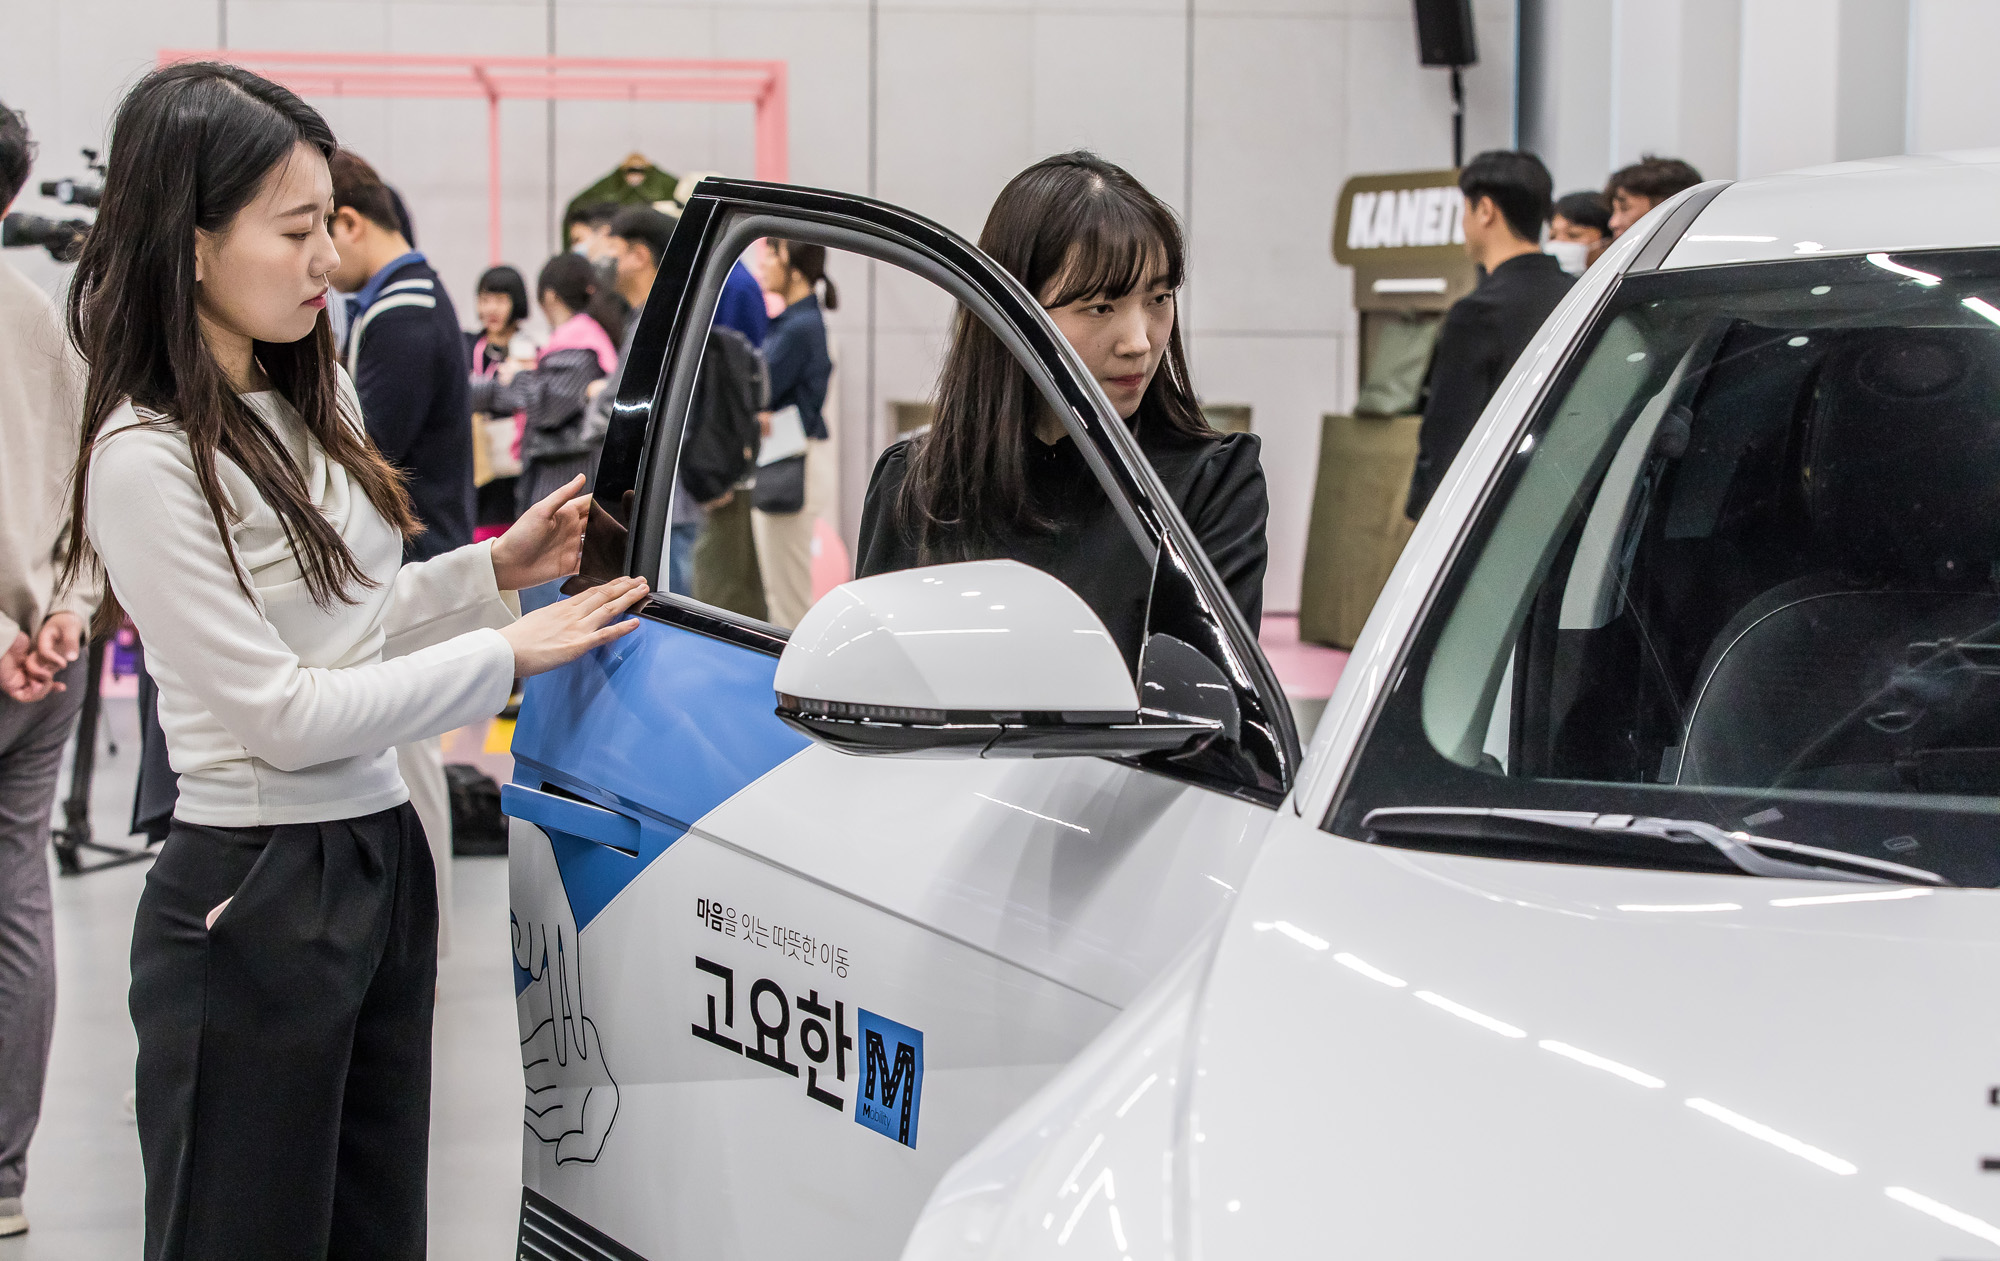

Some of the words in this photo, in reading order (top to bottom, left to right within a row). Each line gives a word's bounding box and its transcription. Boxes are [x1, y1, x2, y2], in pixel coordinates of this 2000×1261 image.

[697, 898, 738, 938] 마음을
[741, 913, 770, 949] 잇는
[772, 925, 818, 967] 따뜻한
[820, 943, 850, 979] 이동
[691, 955, 853, 1112] 고요한
[864, 1028, 916, 1146] M
[862, 1102, 892, 1130] Mobility
